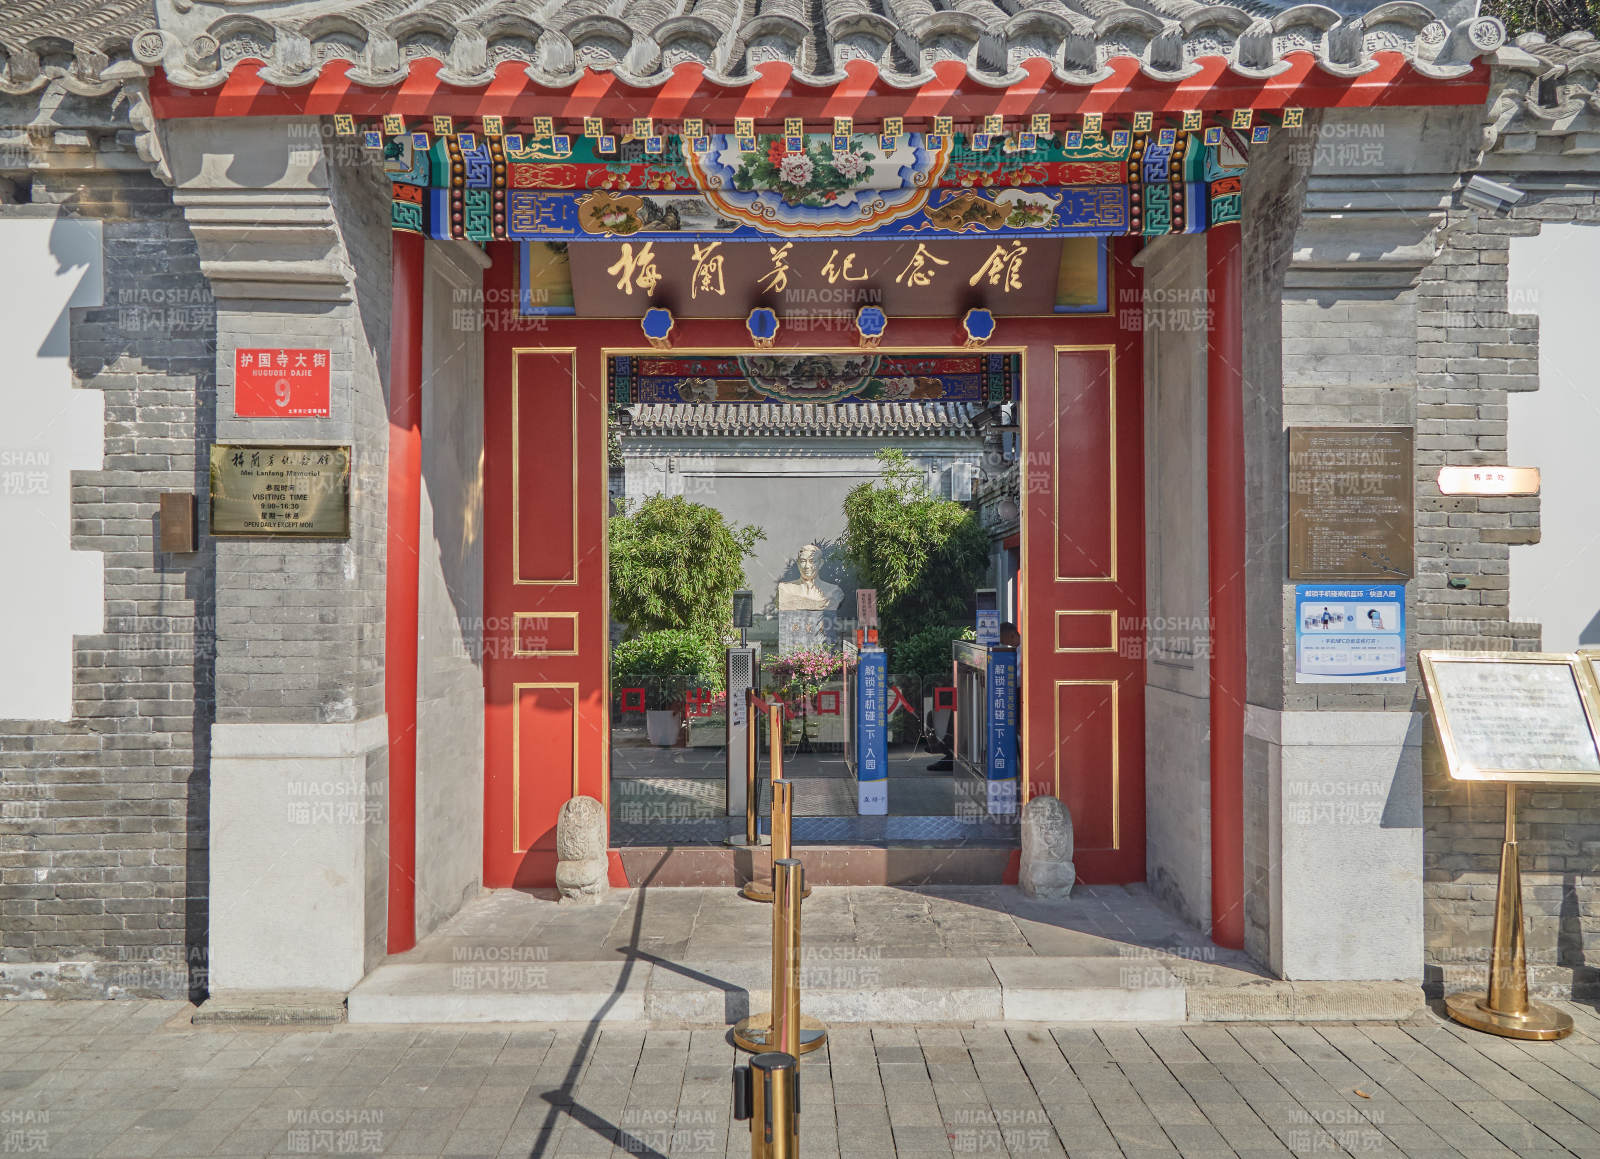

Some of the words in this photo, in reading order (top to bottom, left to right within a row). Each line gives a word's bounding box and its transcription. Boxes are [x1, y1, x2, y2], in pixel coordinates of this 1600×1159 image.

[241, 350, 326, 367] 护国寺大街
[274, 378, 291, 407] 9
